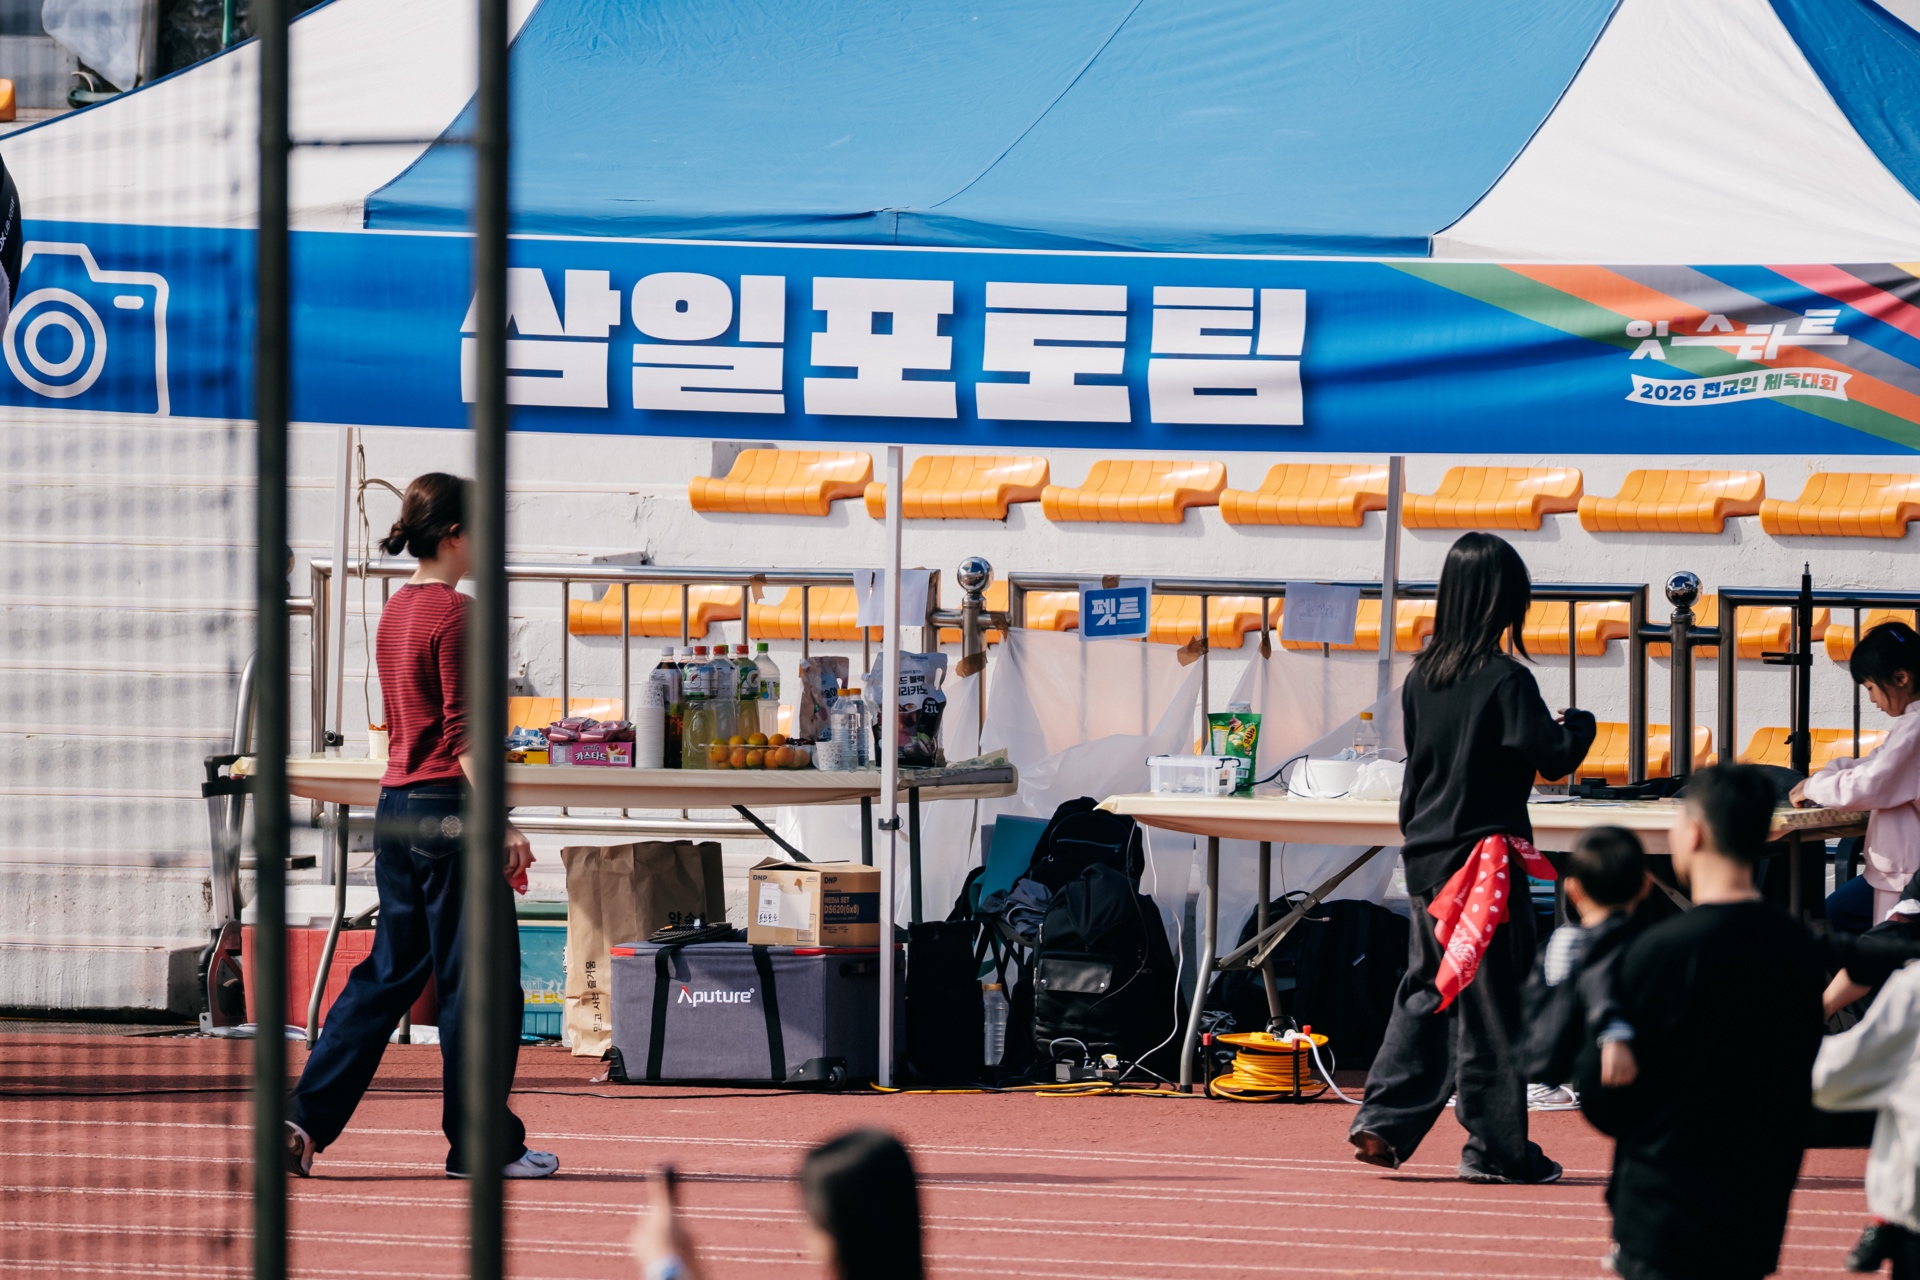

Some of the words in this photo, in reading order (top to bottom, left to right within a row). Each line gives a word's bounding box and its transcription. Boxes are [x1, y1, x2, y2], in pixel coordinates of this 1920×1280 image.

[460, 267, 1307, 426] 삼일포토팀
[1640, 383, 1697, 401] 2026
[1702, 375, 1759, 400] 전교인
[1763, 372, 1839, 392] 체육대회
[898, 684, 929, 697] 리카노
[575, 751, 608, 762] 카스타드
[823, 876, 838, 884] DNP
[840, 896, 850, 904] SET
[585, 960, 597, 990] 즐거움
